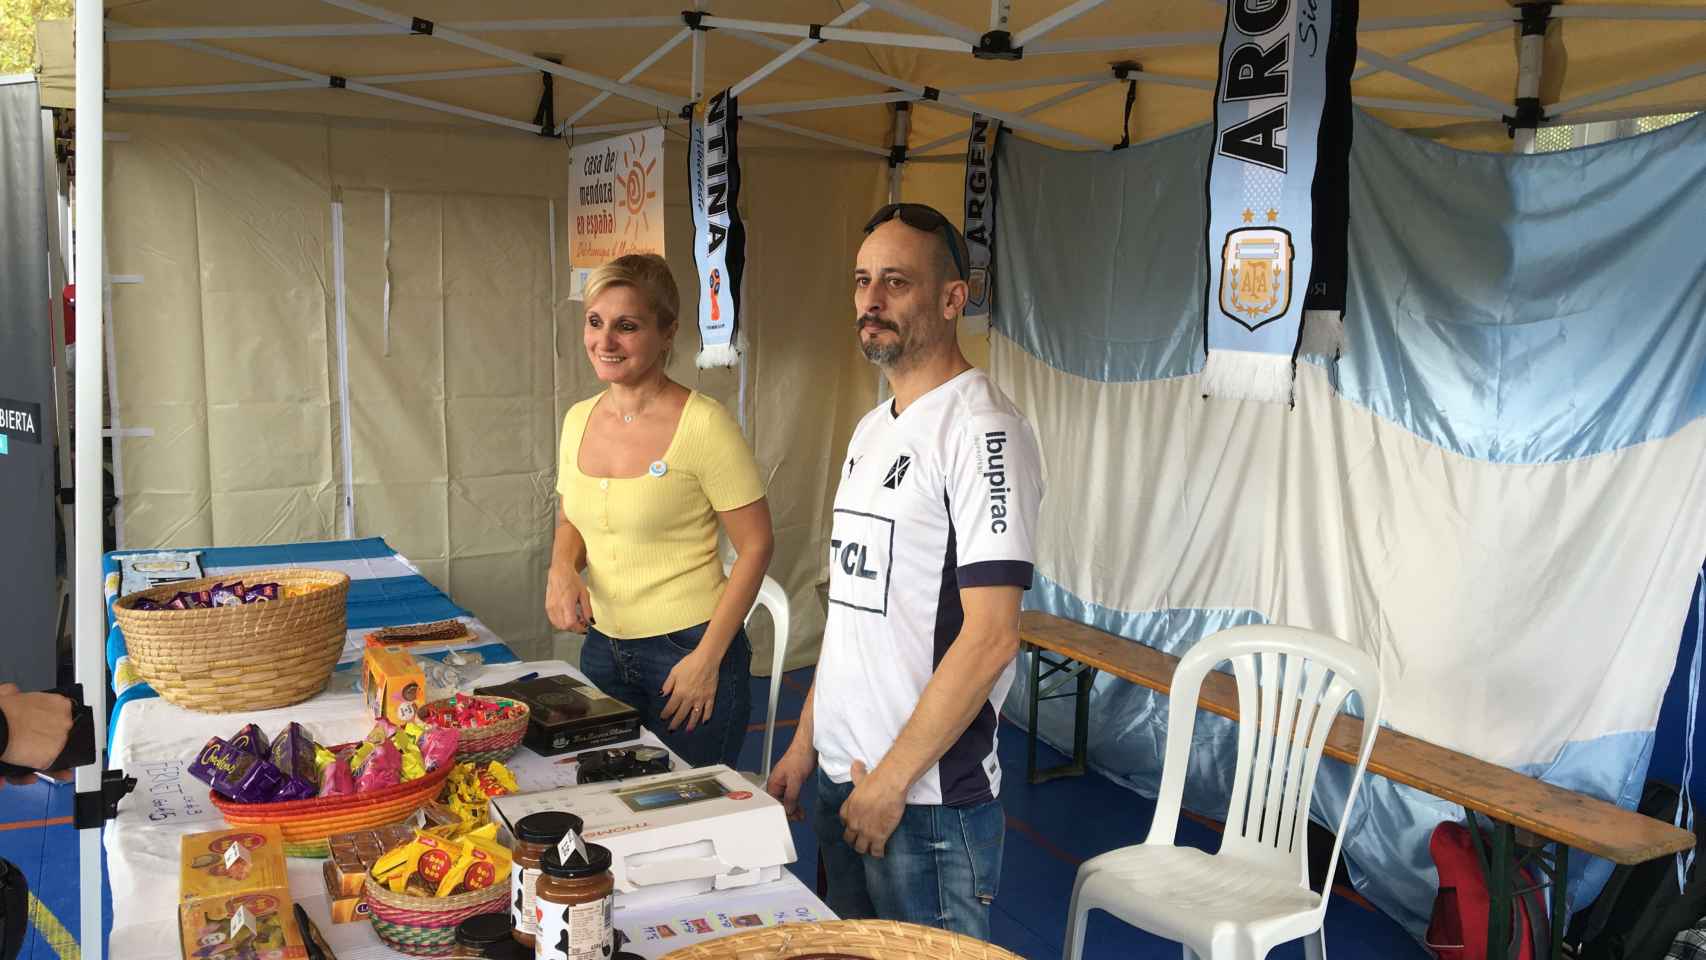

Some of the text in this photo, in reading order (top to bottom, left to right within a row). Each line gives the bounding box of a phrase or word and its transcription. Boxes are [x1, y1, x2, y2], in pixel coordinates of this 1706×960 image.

[584, 147, 615, 176] casa de
[579, 182, 613, 206] mendoza
[576, 210, 614, 239] en españa
[983, 431, 1011, 534] Ibupirac
[831, 539, 878, 580] TCL
